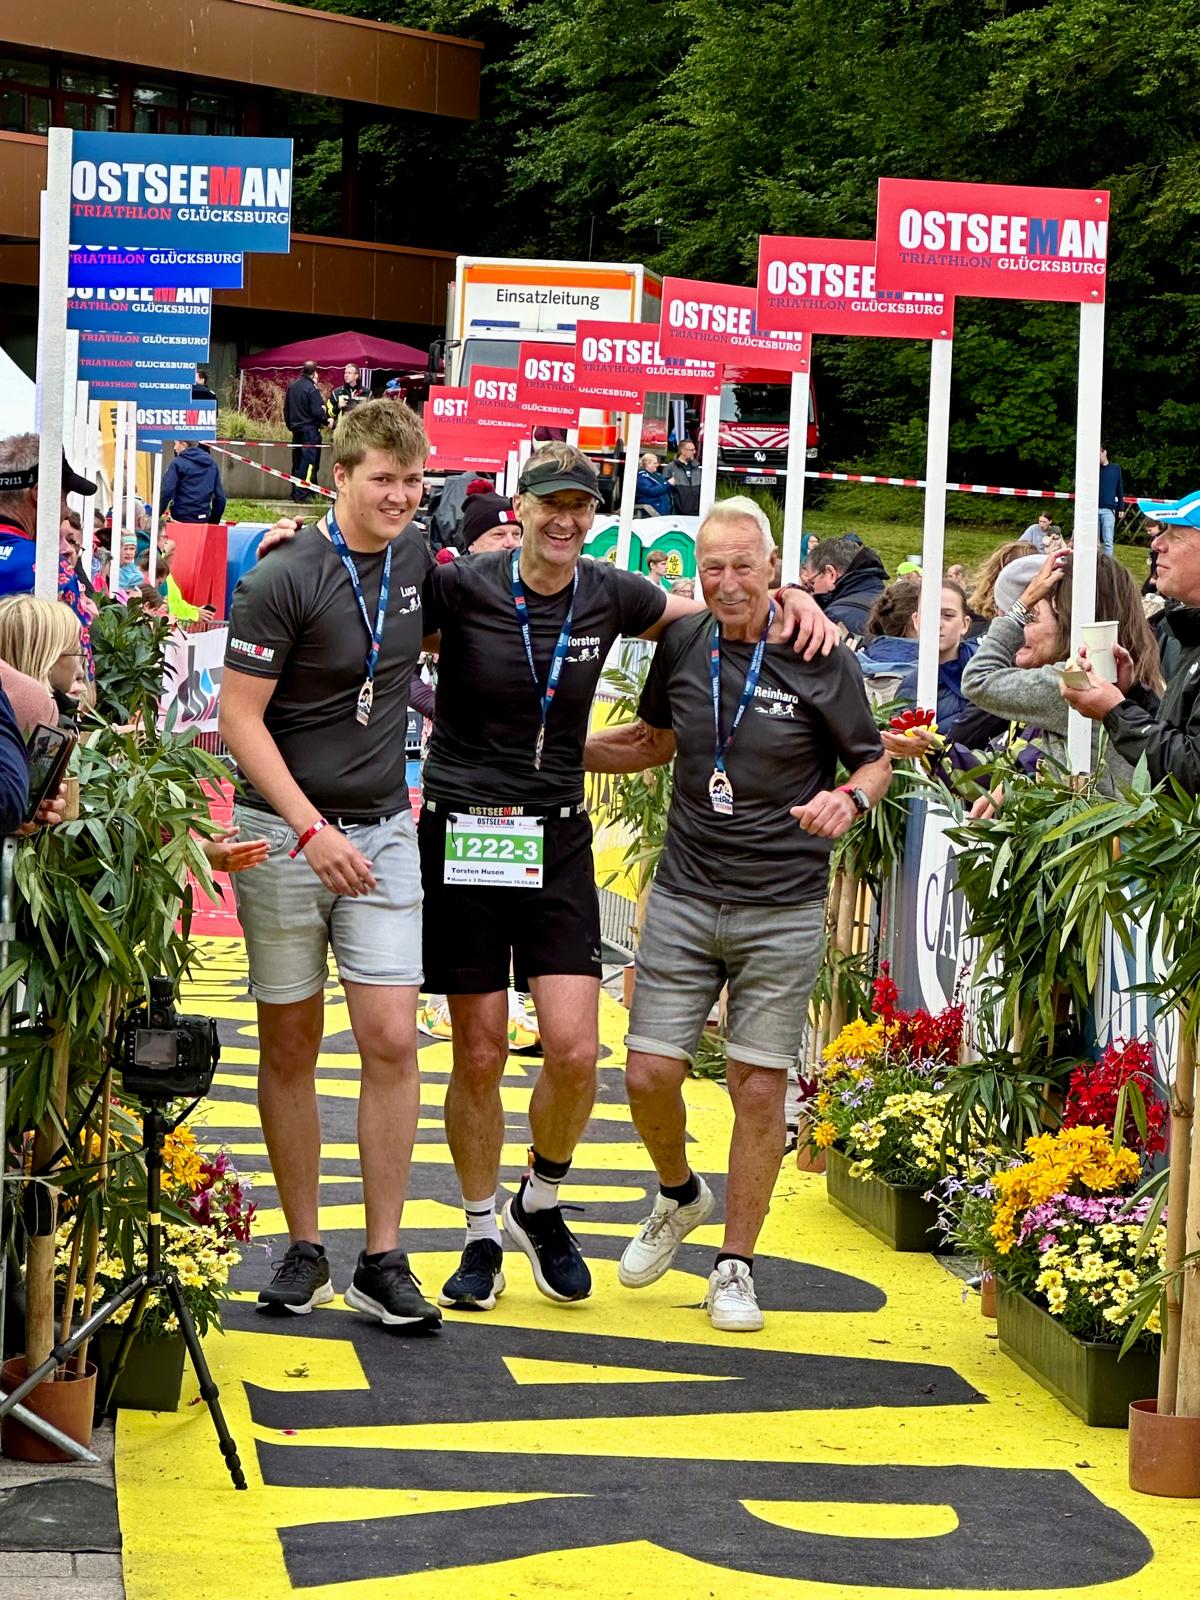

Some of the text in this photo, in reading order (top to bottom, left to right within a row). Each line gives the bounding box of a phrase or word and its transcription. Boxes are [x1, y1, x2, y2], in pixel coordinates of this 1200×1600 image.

[72, 160, 290, 208] OSTSEEMAN
[72, 204, 289, 224] TRIATHLON GLÜCKSBURG
[899, 208, 1107, 259] OSTSEEMAN
[150, 251, 242, 264] GLÜCKSBURG
[900, 252, 1106, 276] TRIATHLON GLÜCKSBURG
[767, 260, 944, 302] OSTSEE
[67, 301, 209, 315] RIATHLON GLÜCKSBURG
[496, 288, 600, 311] Einsatzleitung
[767, 297, 944, 315] TRIATHLON GLÜCKSBURG
[80, 333, 208, 345] TRIATHLON GLÜCKSBURG
[669, 329, 802, 352] TRIATHLON GLÜCKSBURG
[80, 359, 133, 368] TRIATHLON
[583, 363, 715, 378] TRIATHLON GLÜCKSBURG
[136, 409, 216, 425] OSTSEEMAN
[400, 585, 416, 597] Luca
[231, 638, 275, 659] OSTSEEMAN
[469, 806, 524, 817] OSTSEEMAN
[477, 817, 515, 826] OSTSEEMAN
[452, 837, 538, 861] 1222-3
[451, 867, 479, 875] Torsten
